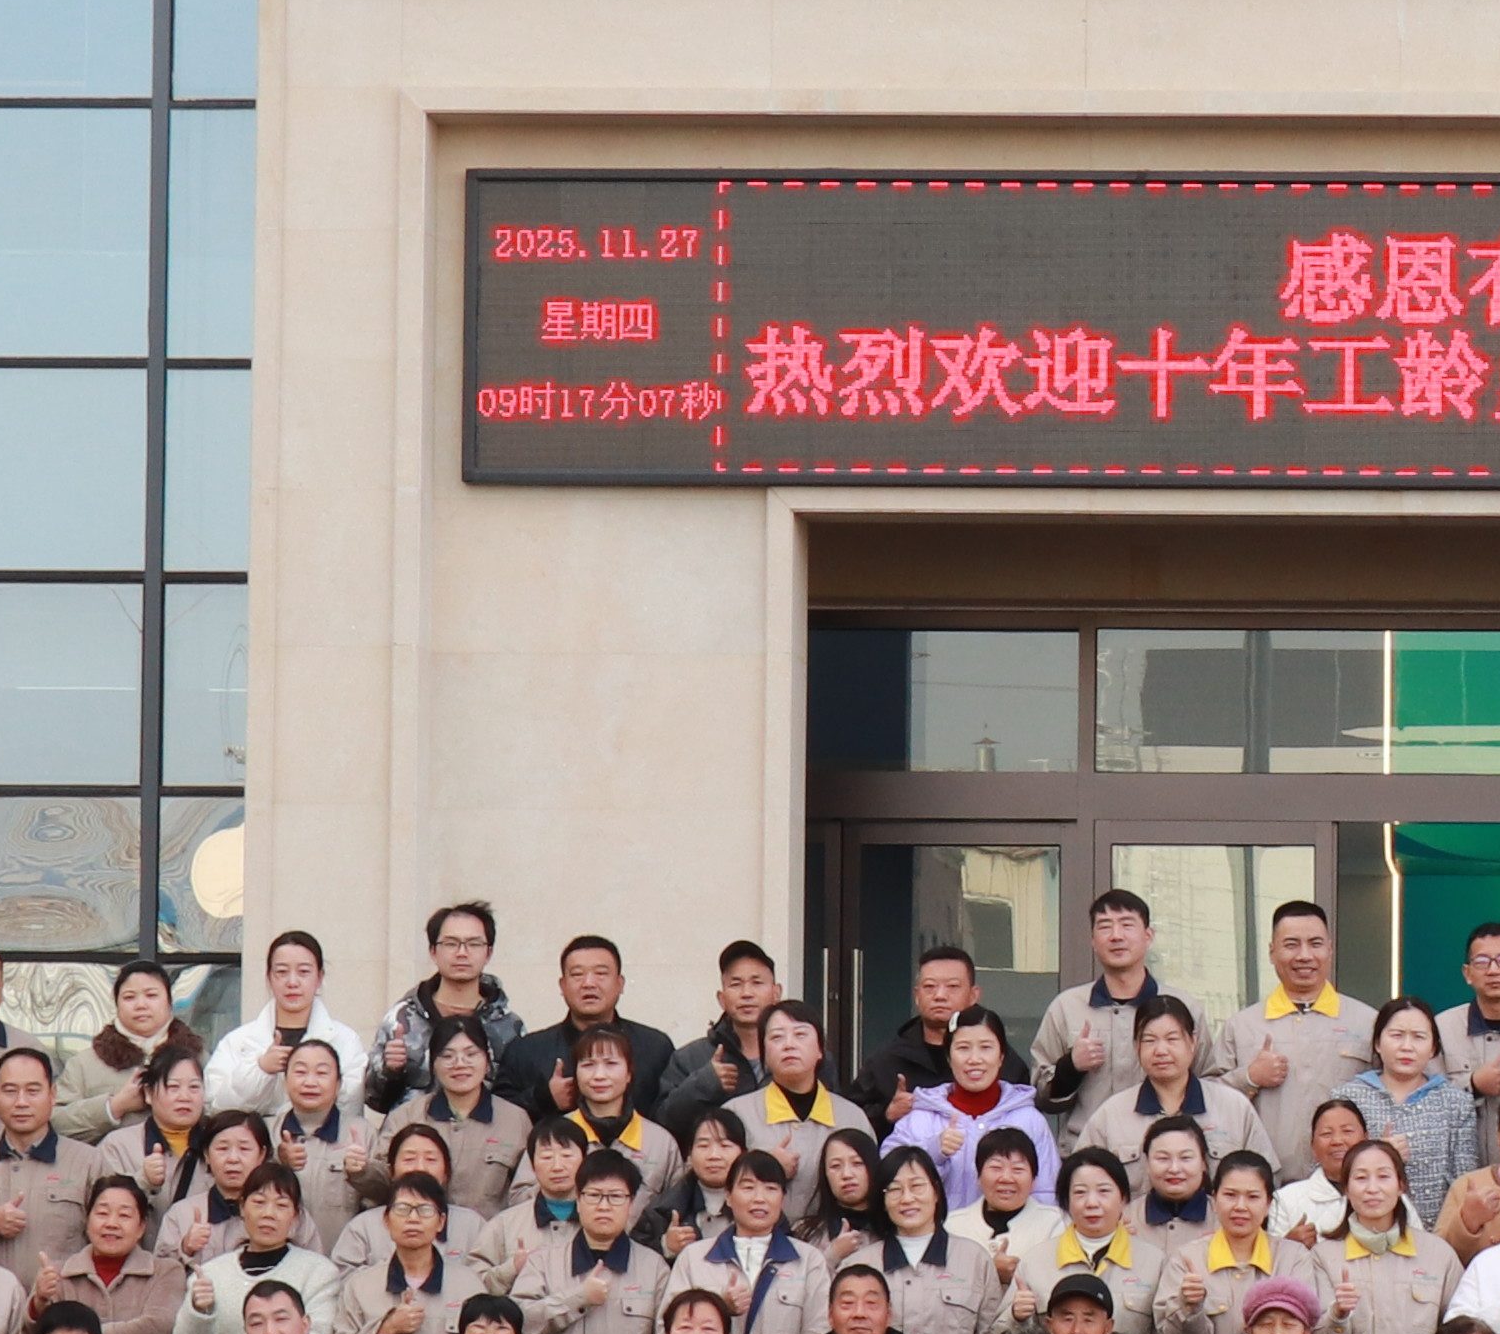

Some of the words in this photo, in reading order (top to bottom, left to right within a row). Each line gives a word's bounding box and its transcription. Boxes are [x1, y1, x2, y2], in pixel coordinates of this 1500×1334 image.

[495, 228, 698, 259] 2025.11.27
[541, 299, 656, 342] 星期四
[477, 381, 717, 421] 09时17分07秒
